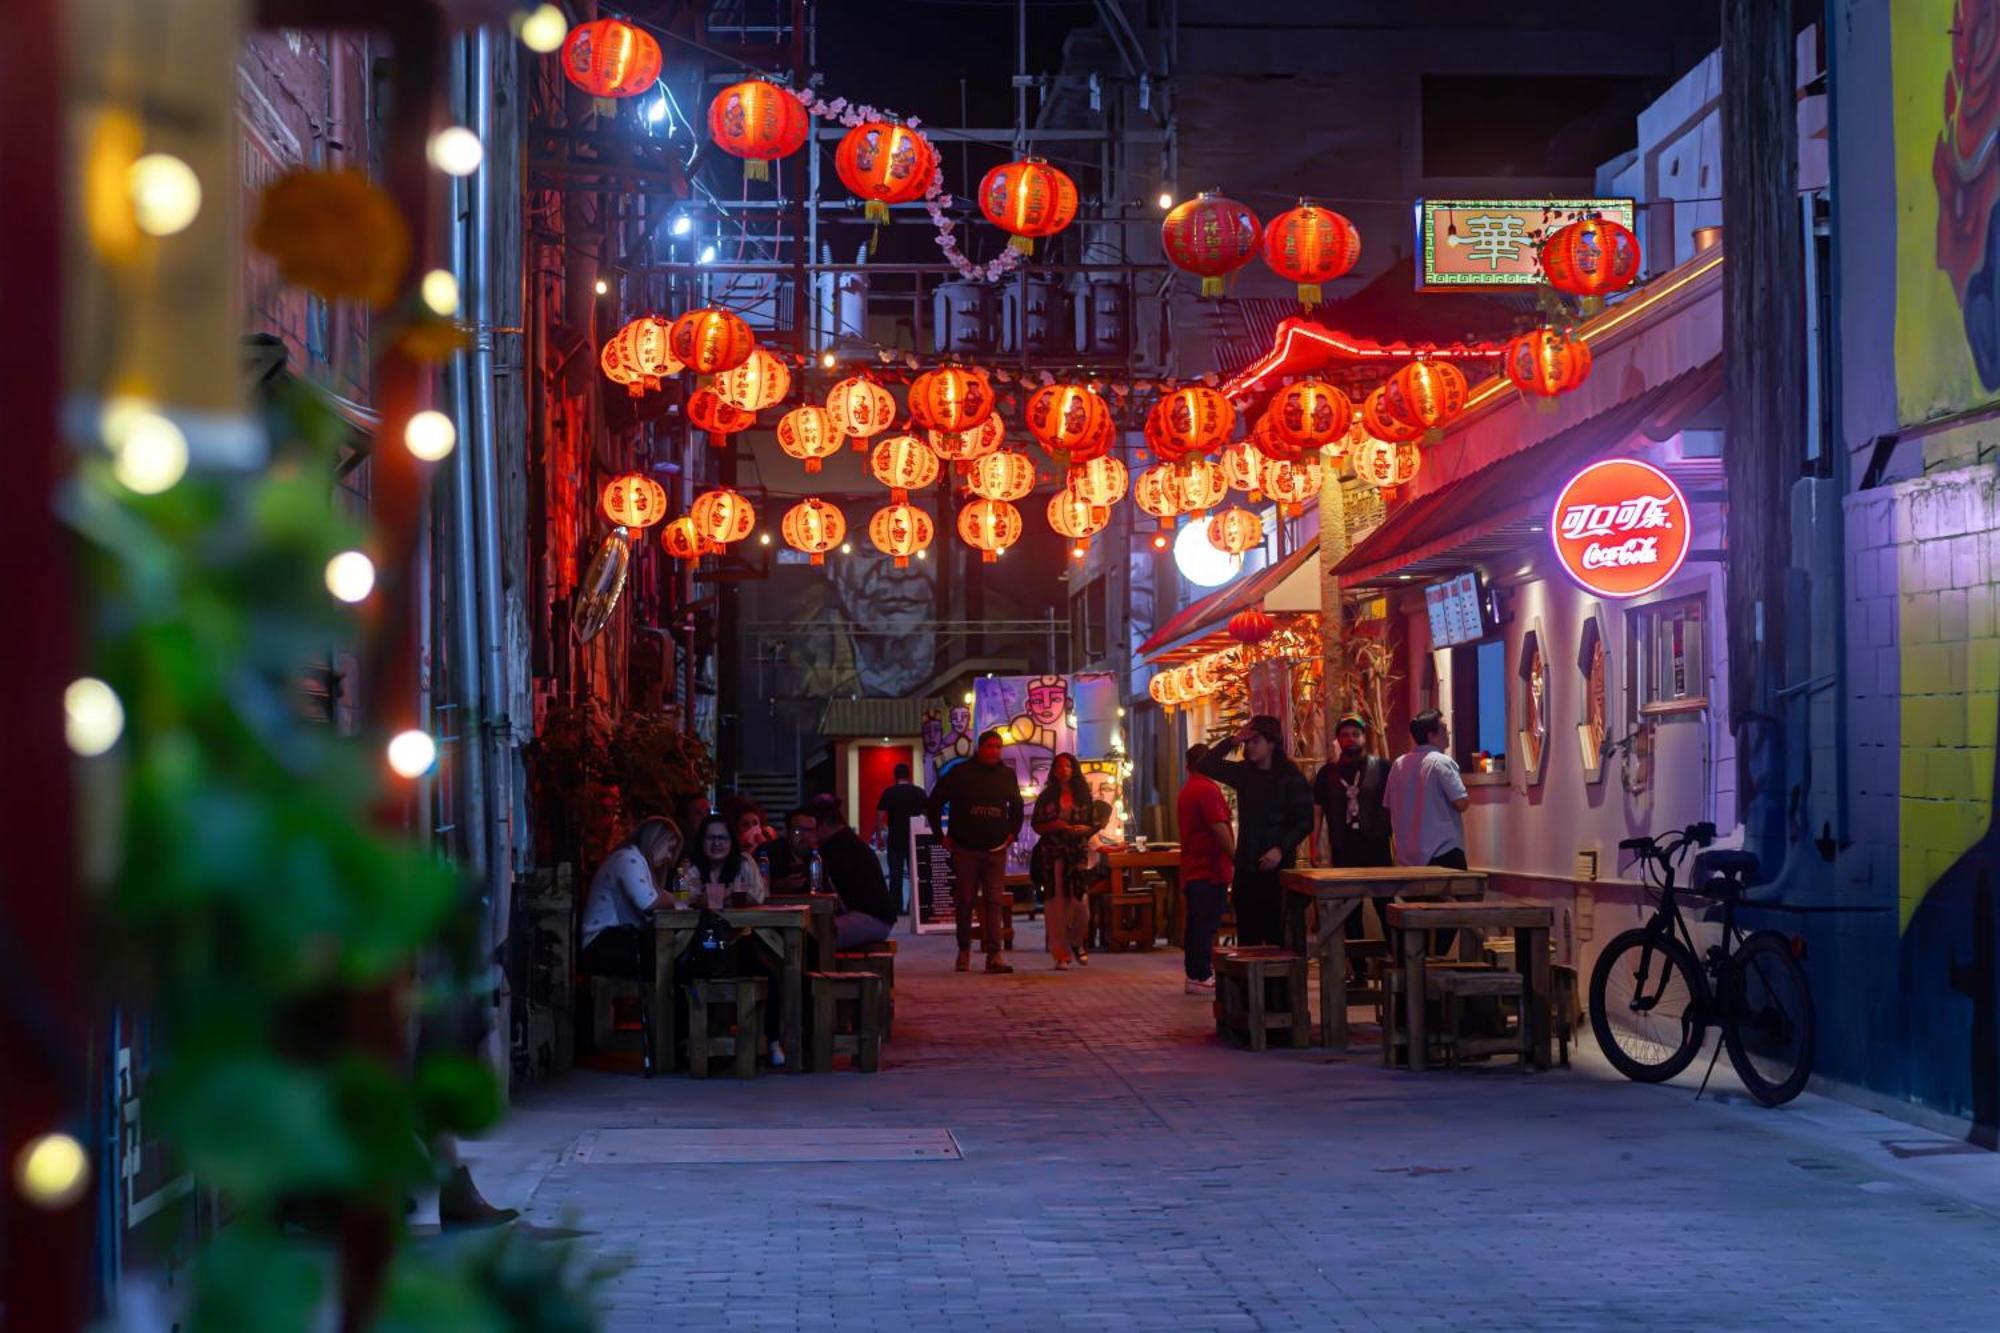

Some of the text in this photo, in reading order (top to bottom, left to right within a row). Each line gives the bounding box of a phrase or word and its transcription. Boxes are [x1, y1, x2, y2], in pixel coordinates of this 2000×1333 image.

[1452, 213, 1562, 270] 華
[1561, 494, 1675, 539] 可口可乐
